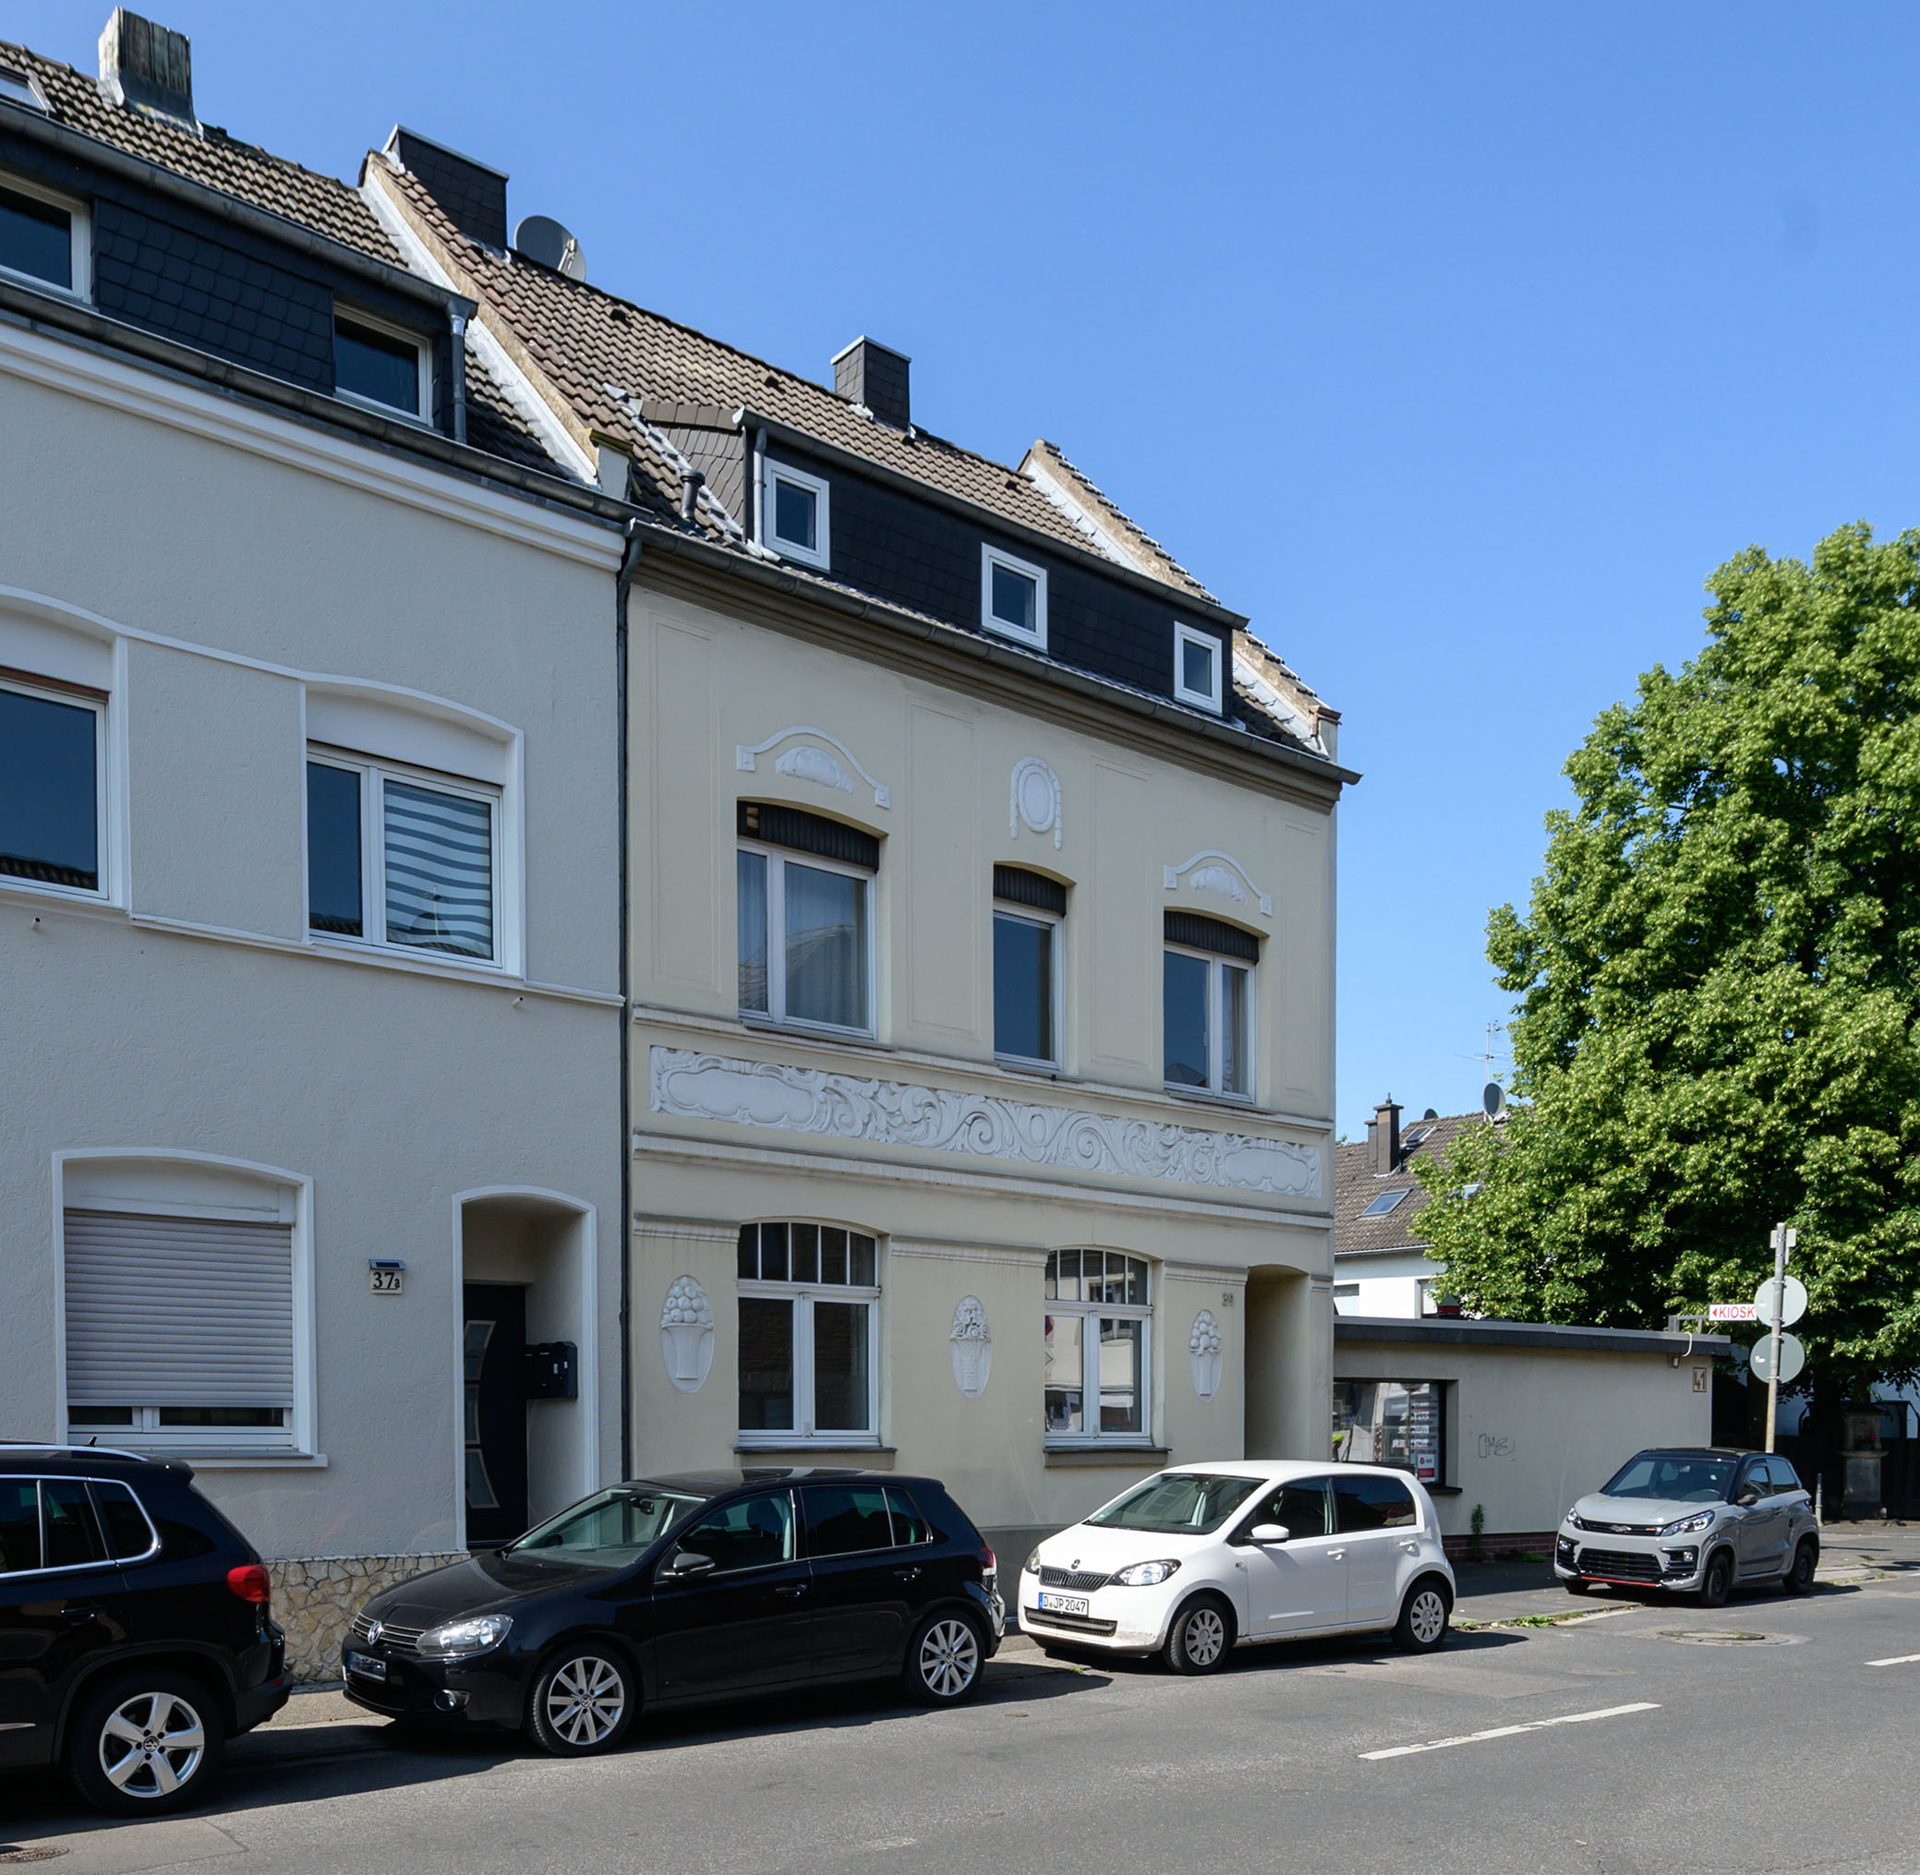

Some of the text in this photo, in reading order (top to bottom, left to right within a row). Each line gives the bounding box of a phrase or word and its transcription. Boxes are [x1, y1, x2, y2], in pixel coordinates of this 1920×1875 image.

[373, 1271, 400, 1289] 37a
[1719, 1306, 1756, 1319] KIOSK
[1065, 1599, 1087, 1612] 2047
